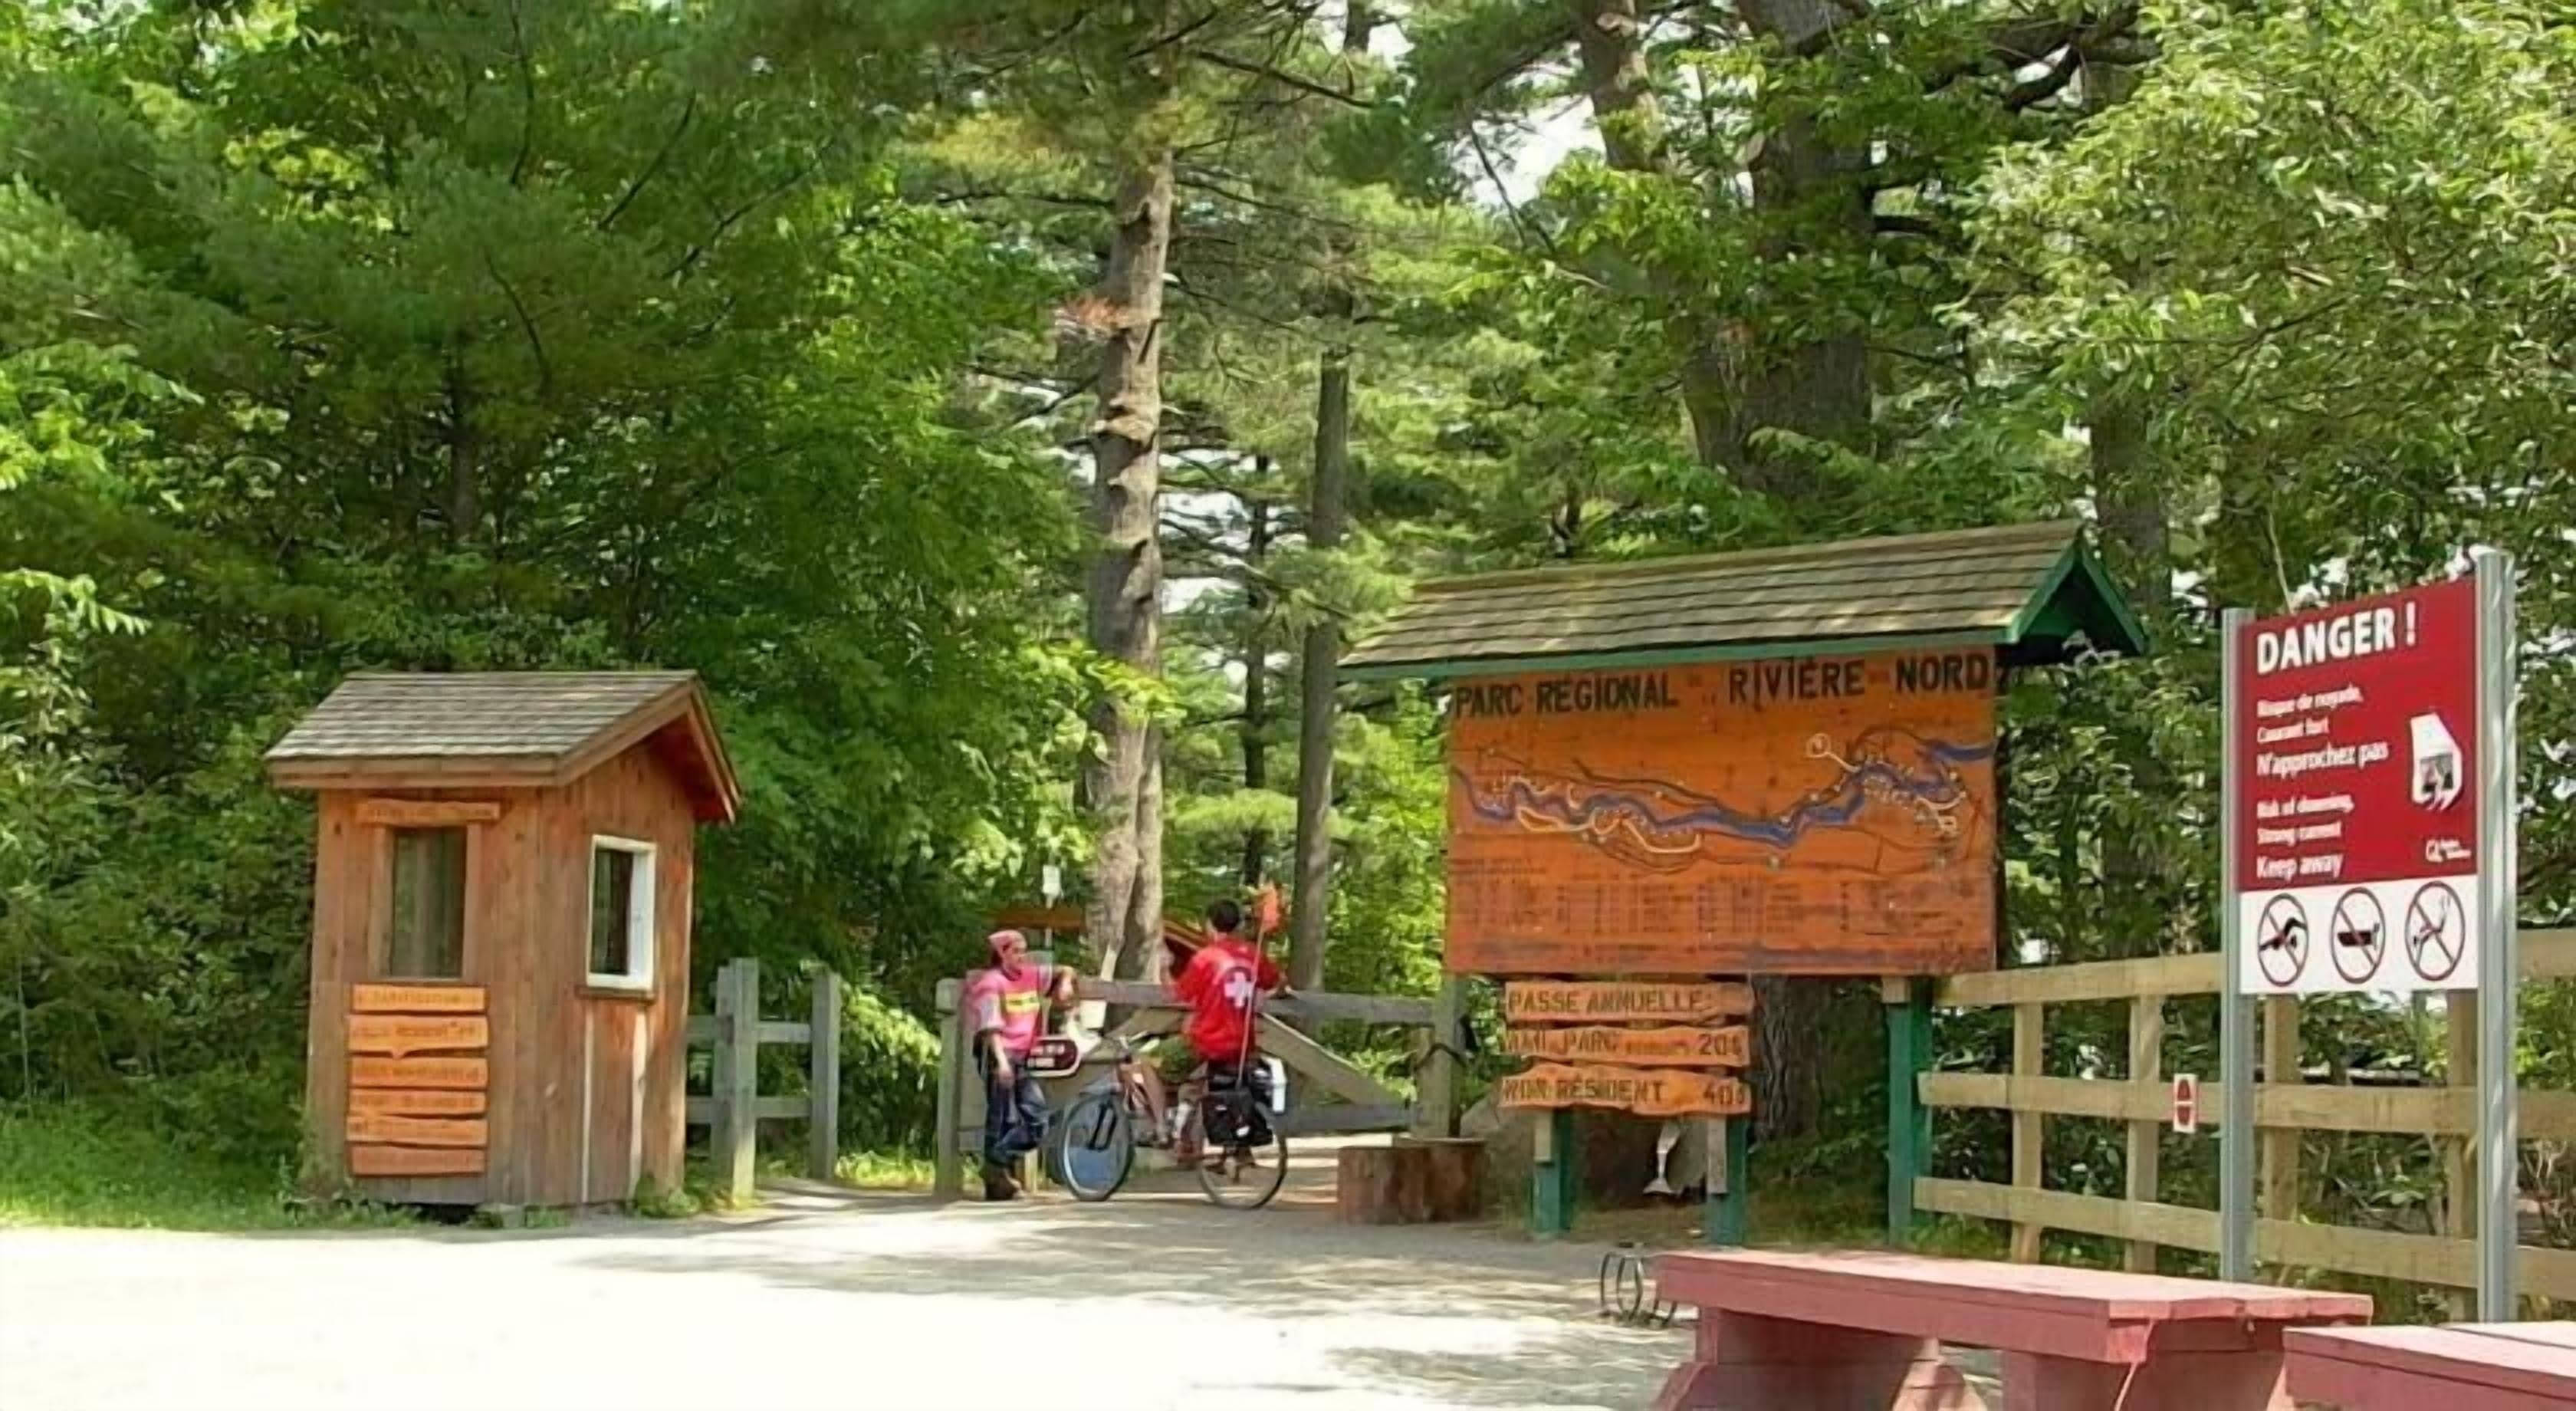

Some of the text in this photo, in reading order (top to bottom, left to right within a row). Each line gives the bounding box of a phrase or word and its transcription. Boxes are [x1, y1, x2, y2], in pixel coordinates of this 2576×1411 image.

[2257, 601, 2416, 674] DANGER !
[1455, 682, 1524, 719] PARC
[1894, 652, 1990, 693] NORD
[2257, 742, 2388, 778] N'approchez pas
[2256, 854, 2343, 880] Keep away
[1506, 989, 1580, 1013] PASSE
[1503, 1078, 1549, 1103] NON
